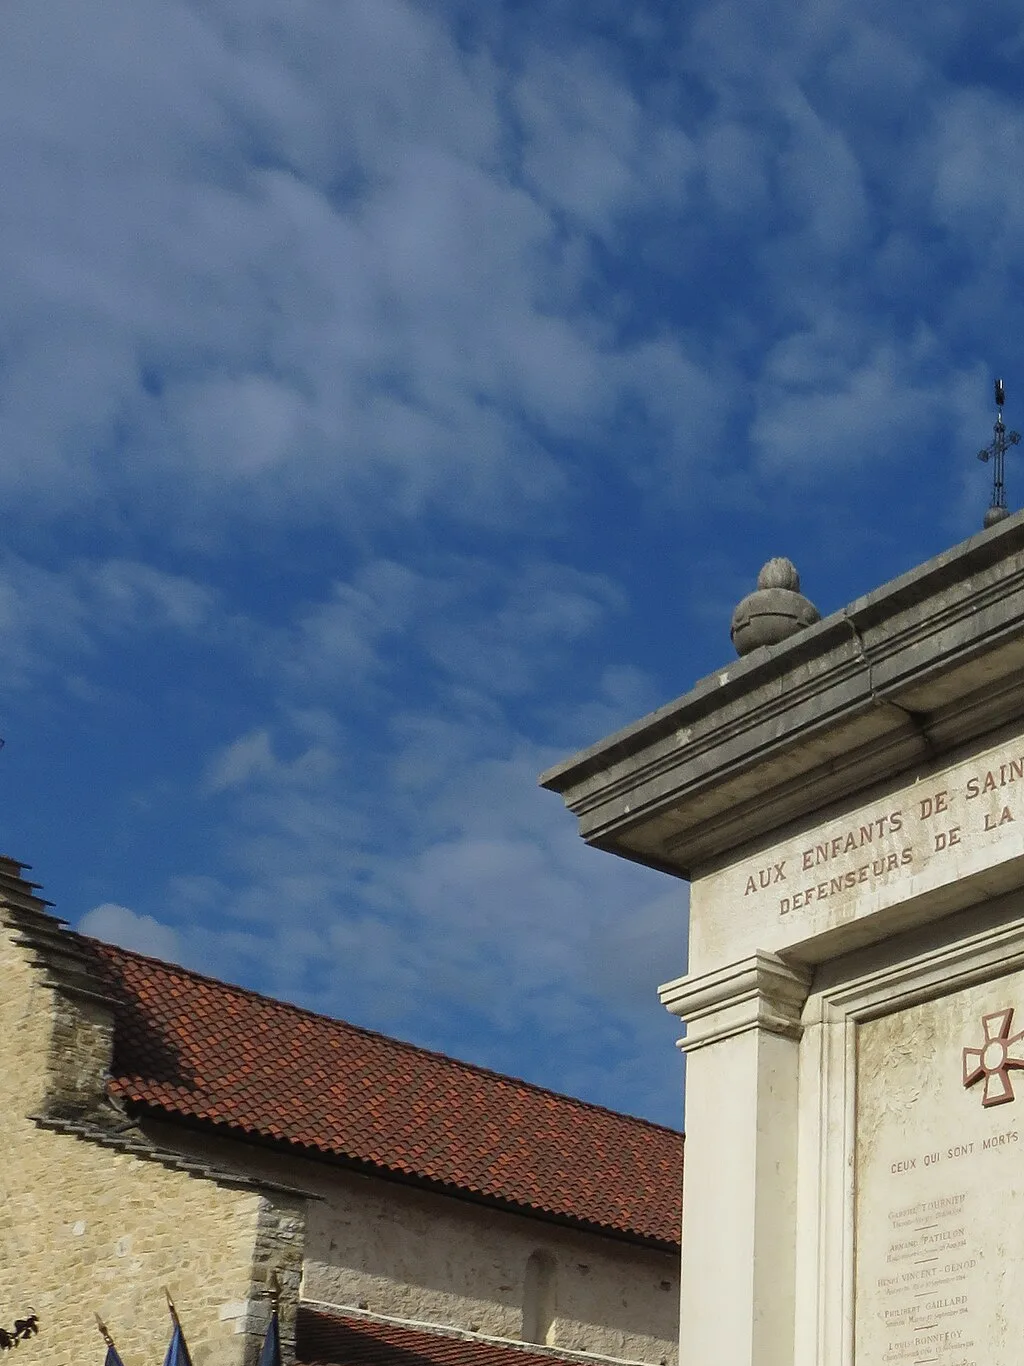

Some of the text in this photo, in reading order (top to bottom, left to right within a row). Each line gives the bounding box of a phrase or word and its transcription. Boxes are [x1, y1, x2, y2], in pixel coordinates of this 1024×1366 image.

[743, 860, 787, 896] AUX
[801, 812, 902, 869] ENFANTS
[919, 790, 949, 820] DE
[779, 848, 913, 916] DEFENSEURS
[934, 827, 961, 852] DE
[983, 806, 1014, 831] LA
[891, 1158, 916, 1174] CEUX
[924, 1152, 940, 1166] QUI
[947, 1143, 974, 1159] SONT
[982, 1132, 1019, 1149] MORTS
[926, 1295, 968, 1310] GAILLARD
